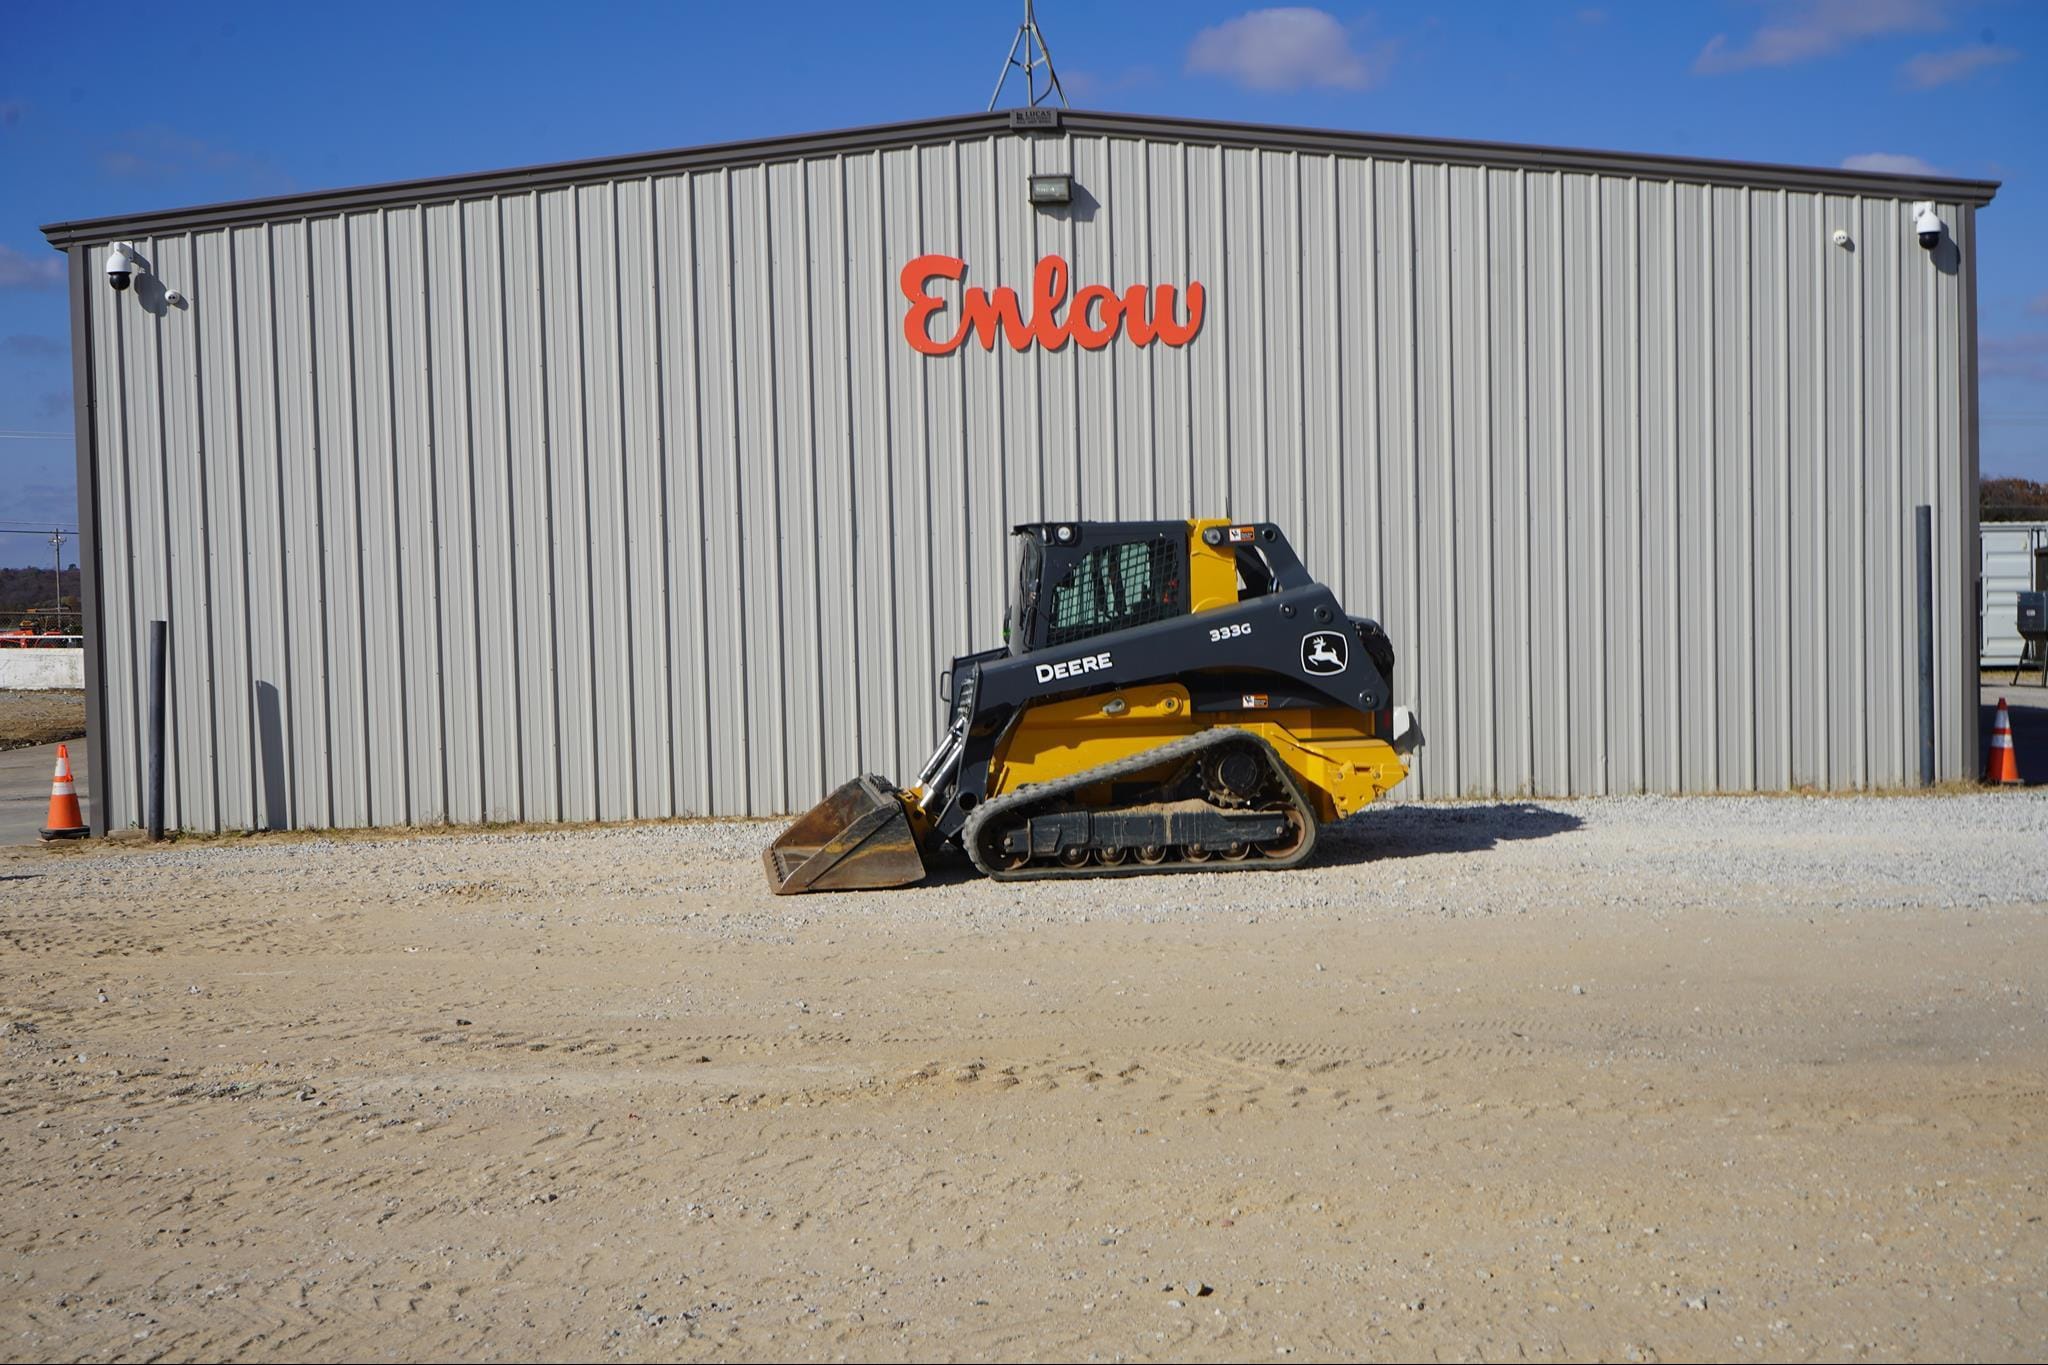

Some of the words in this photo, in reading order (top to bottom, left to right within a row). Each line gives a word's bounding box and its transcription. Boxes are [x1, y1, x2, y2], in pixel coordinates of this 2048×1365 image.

[900, 254, 1203, 354] Enlow
[1209, 622, 1252, 642] 333G
[1035, 652, 1113, 684] DEERE
